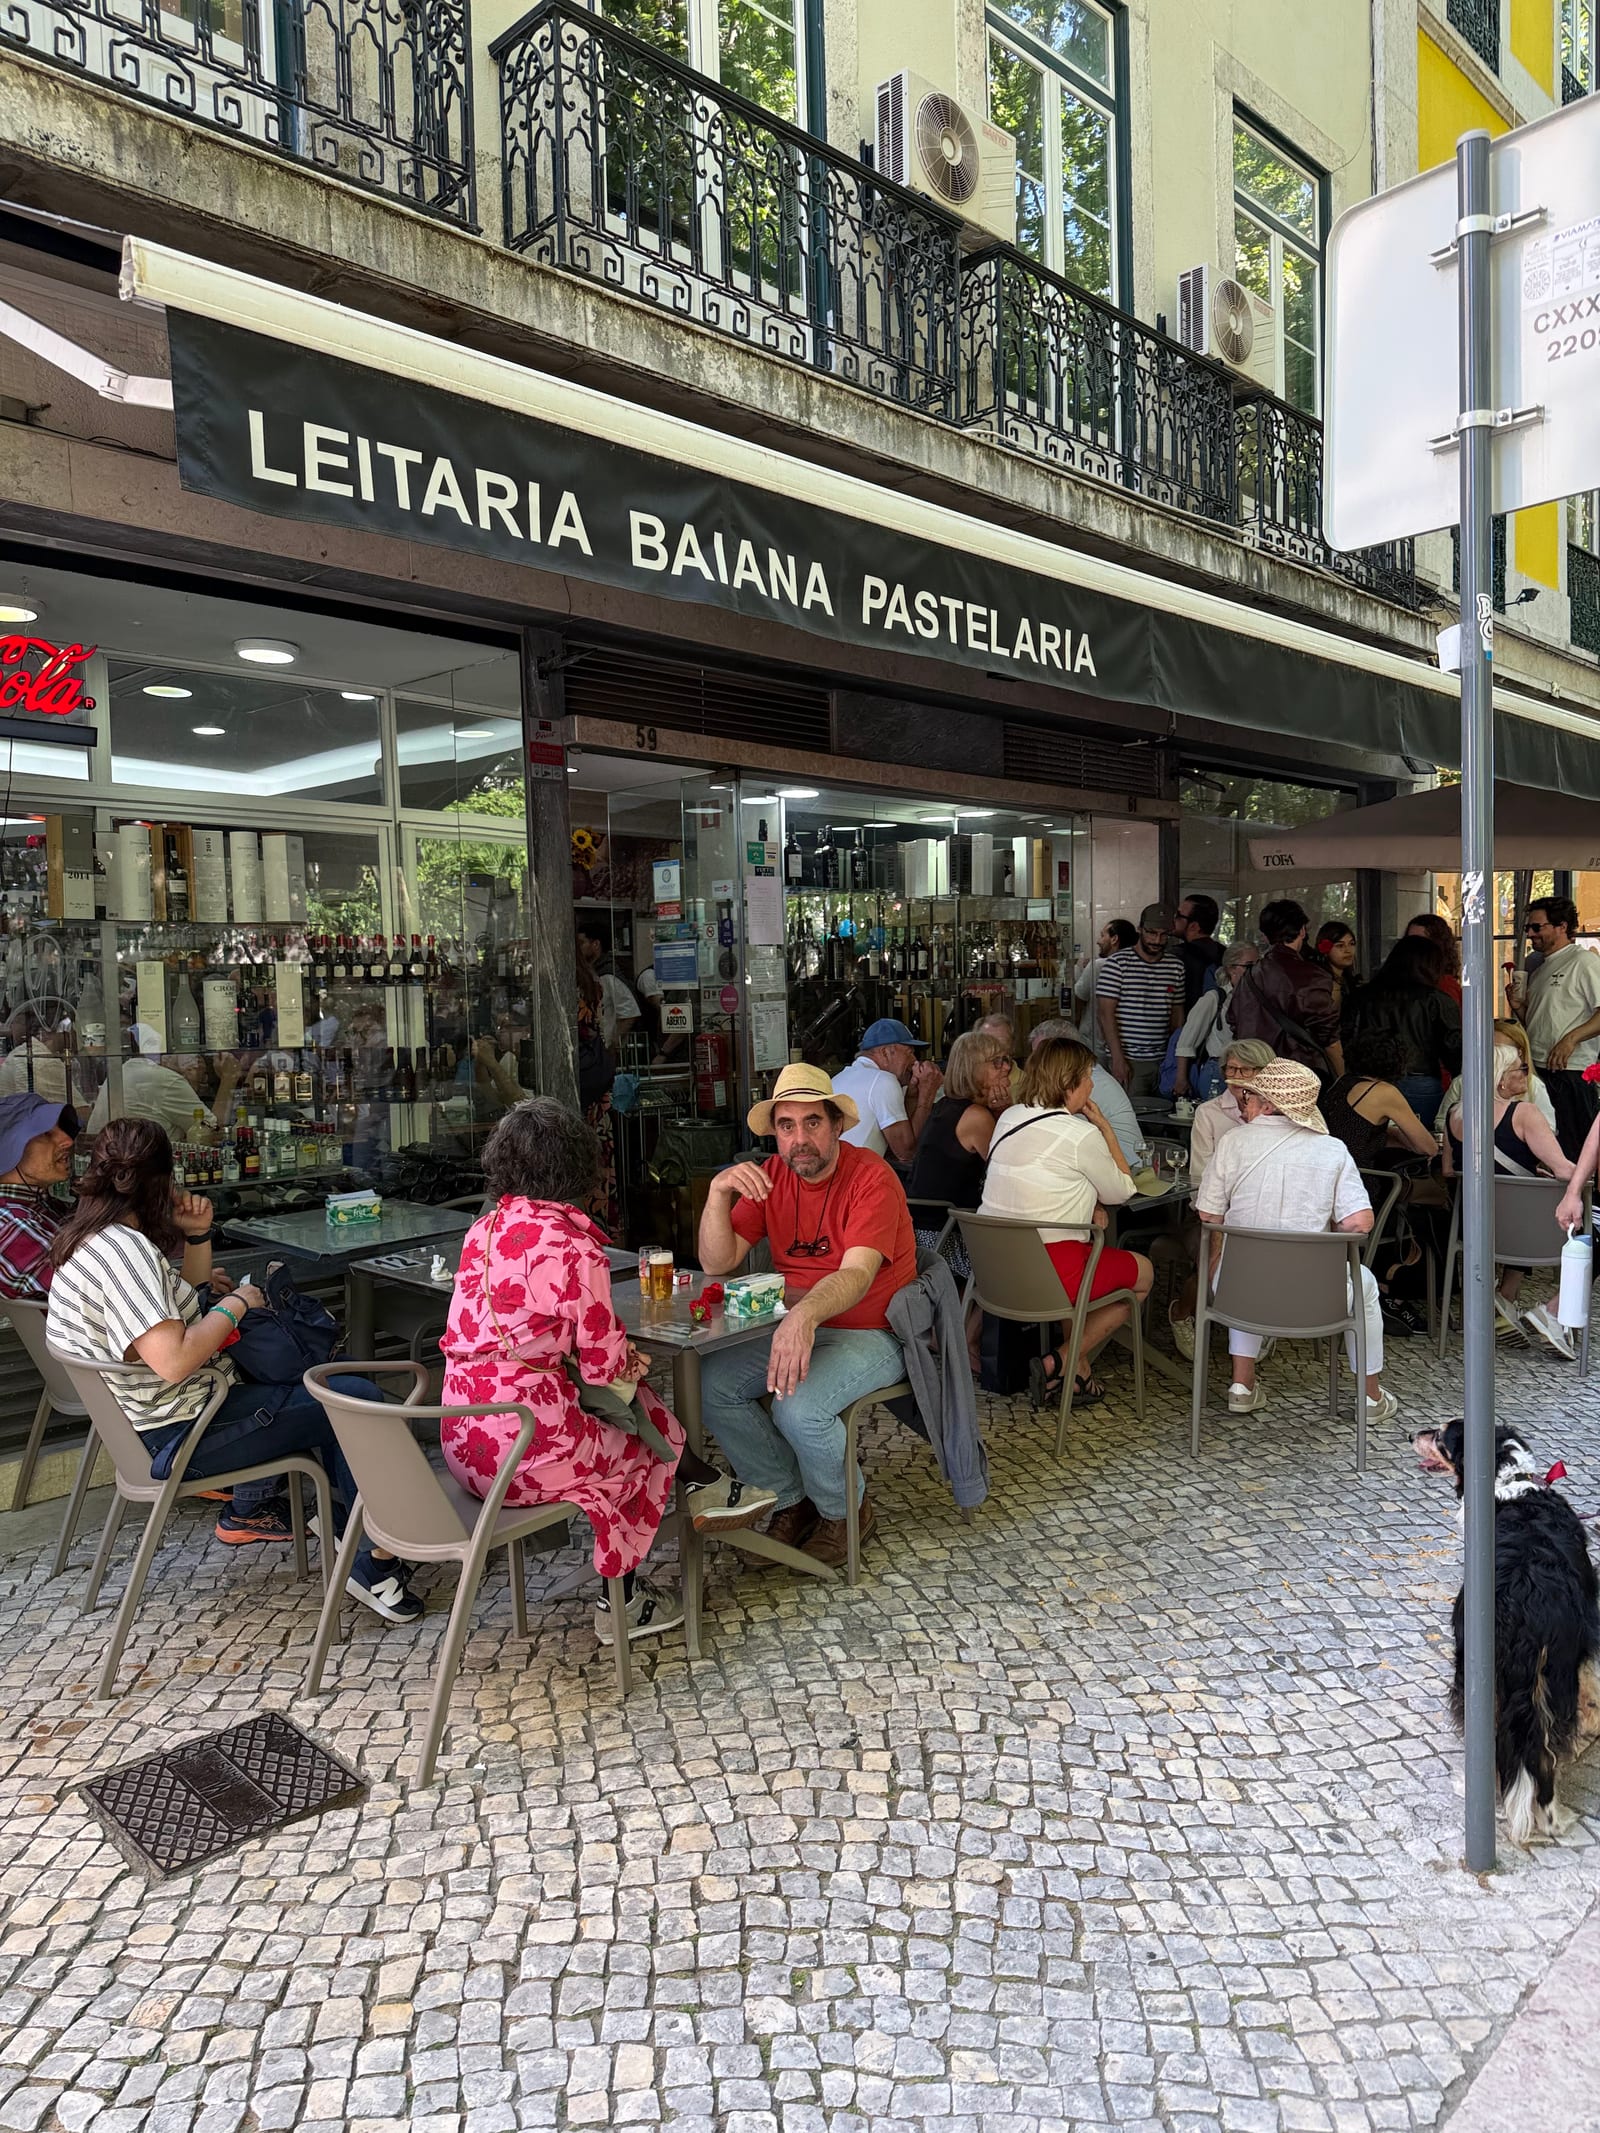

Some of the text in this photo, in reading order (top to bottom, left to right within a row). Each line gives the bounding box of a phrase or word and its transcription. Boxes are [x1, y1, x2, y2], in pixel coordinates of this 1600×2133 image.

[1547, 328, 1600, 362] 220
[248, 409, 1098, 678] LEITARIA BAIANA PASTELARIA
[0, 645, 90, 715] ola
[636, 725, 657, 751] 59
[1263, 855, 1295, 866] TOFA
[666, 1015, 687, 1026] ABERTO
